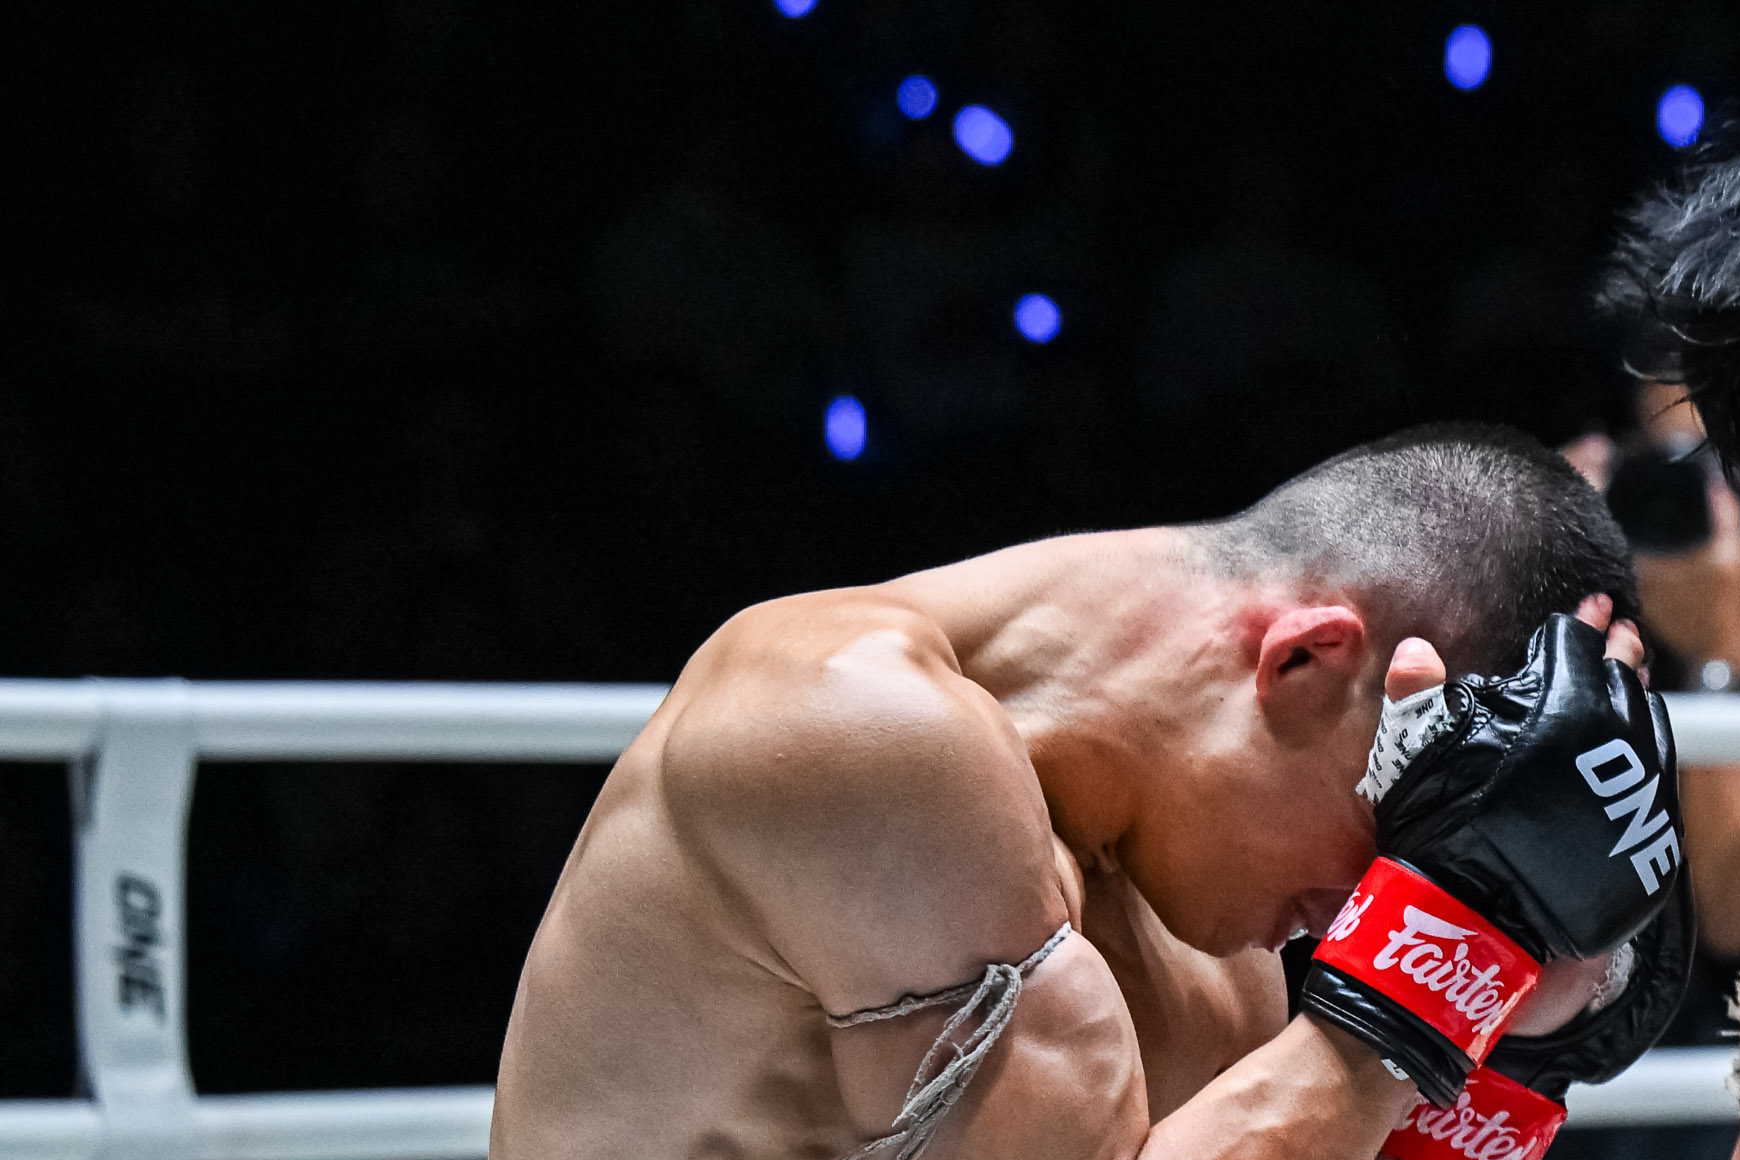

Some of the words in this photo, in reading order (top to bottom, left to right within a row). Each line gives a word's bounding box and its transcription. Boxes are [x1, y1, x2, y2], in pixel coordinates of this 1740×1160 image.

[1575, 739, 1680, 896] ONE
[114, 870, 167, 1026] ONE
[1373, 905, 1519, 1036] Fairtex
